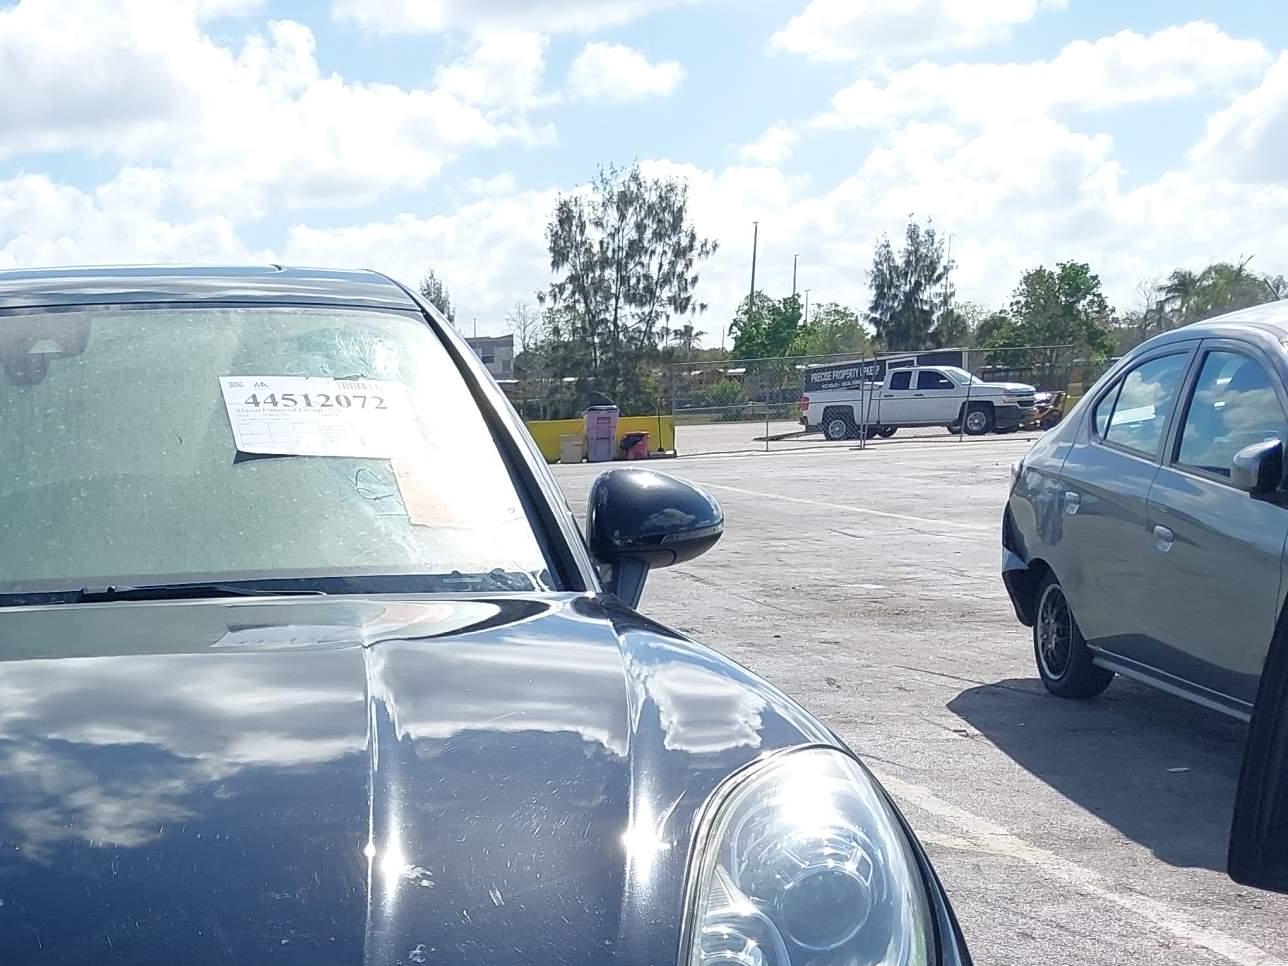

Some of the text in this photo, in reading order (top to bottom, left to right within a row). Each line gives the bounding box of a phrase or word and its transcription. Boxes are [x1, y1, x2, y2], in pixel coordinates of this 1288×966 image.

[810, 372, 832, 383] PRECISE
[832, 367, 859, 380] PROPERTY
[244, 393, 388, 410] 44512072
